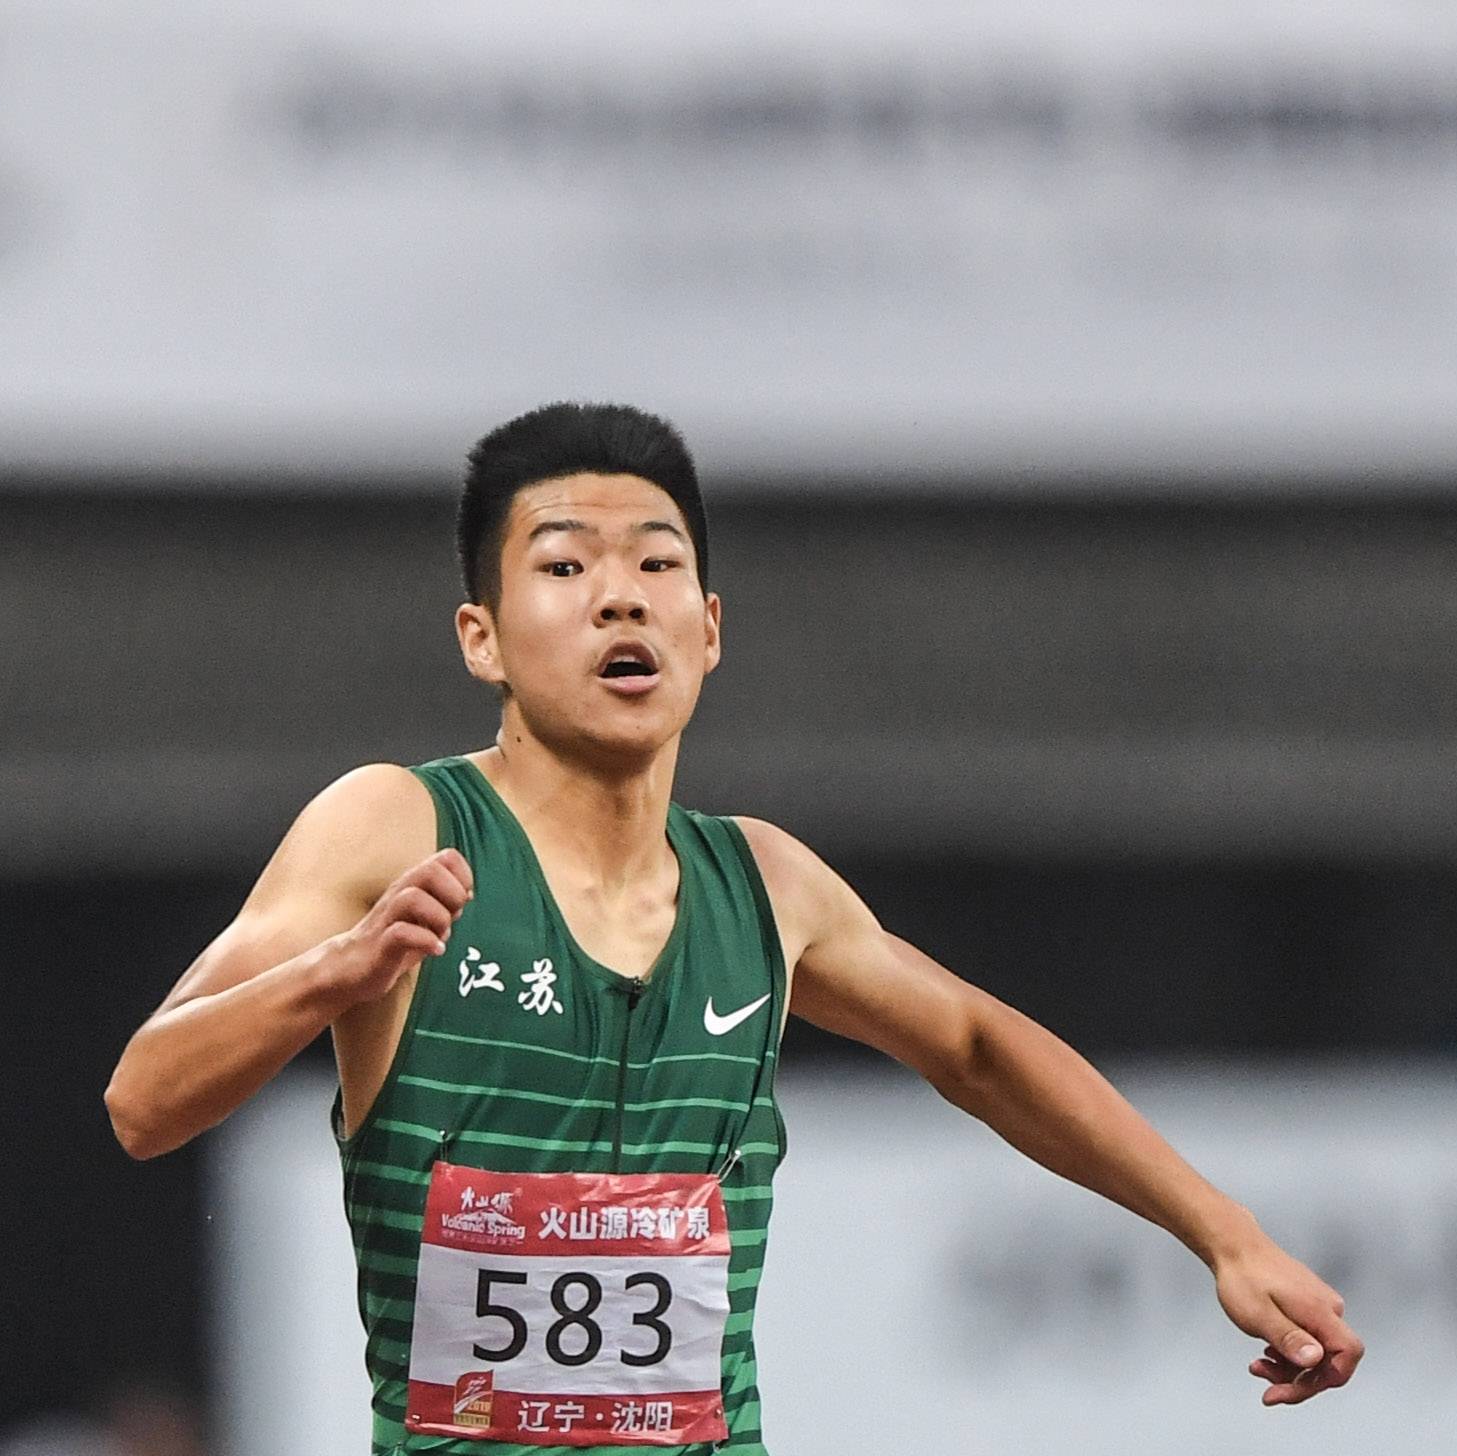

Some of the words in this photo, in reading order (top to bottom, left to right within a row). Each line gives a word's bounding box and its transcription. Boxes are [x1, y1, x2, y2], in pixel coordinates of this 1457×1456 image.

[458, 946, 564, 1016] 江苏
[487, 1220, 526, 1240] Spring
[538, 1205, 711, 1241] 火山源冷矿泉
[471, 1267, 674, 1367] 583
[517, 1400, 674, 1433] 辽宁·沈阳
